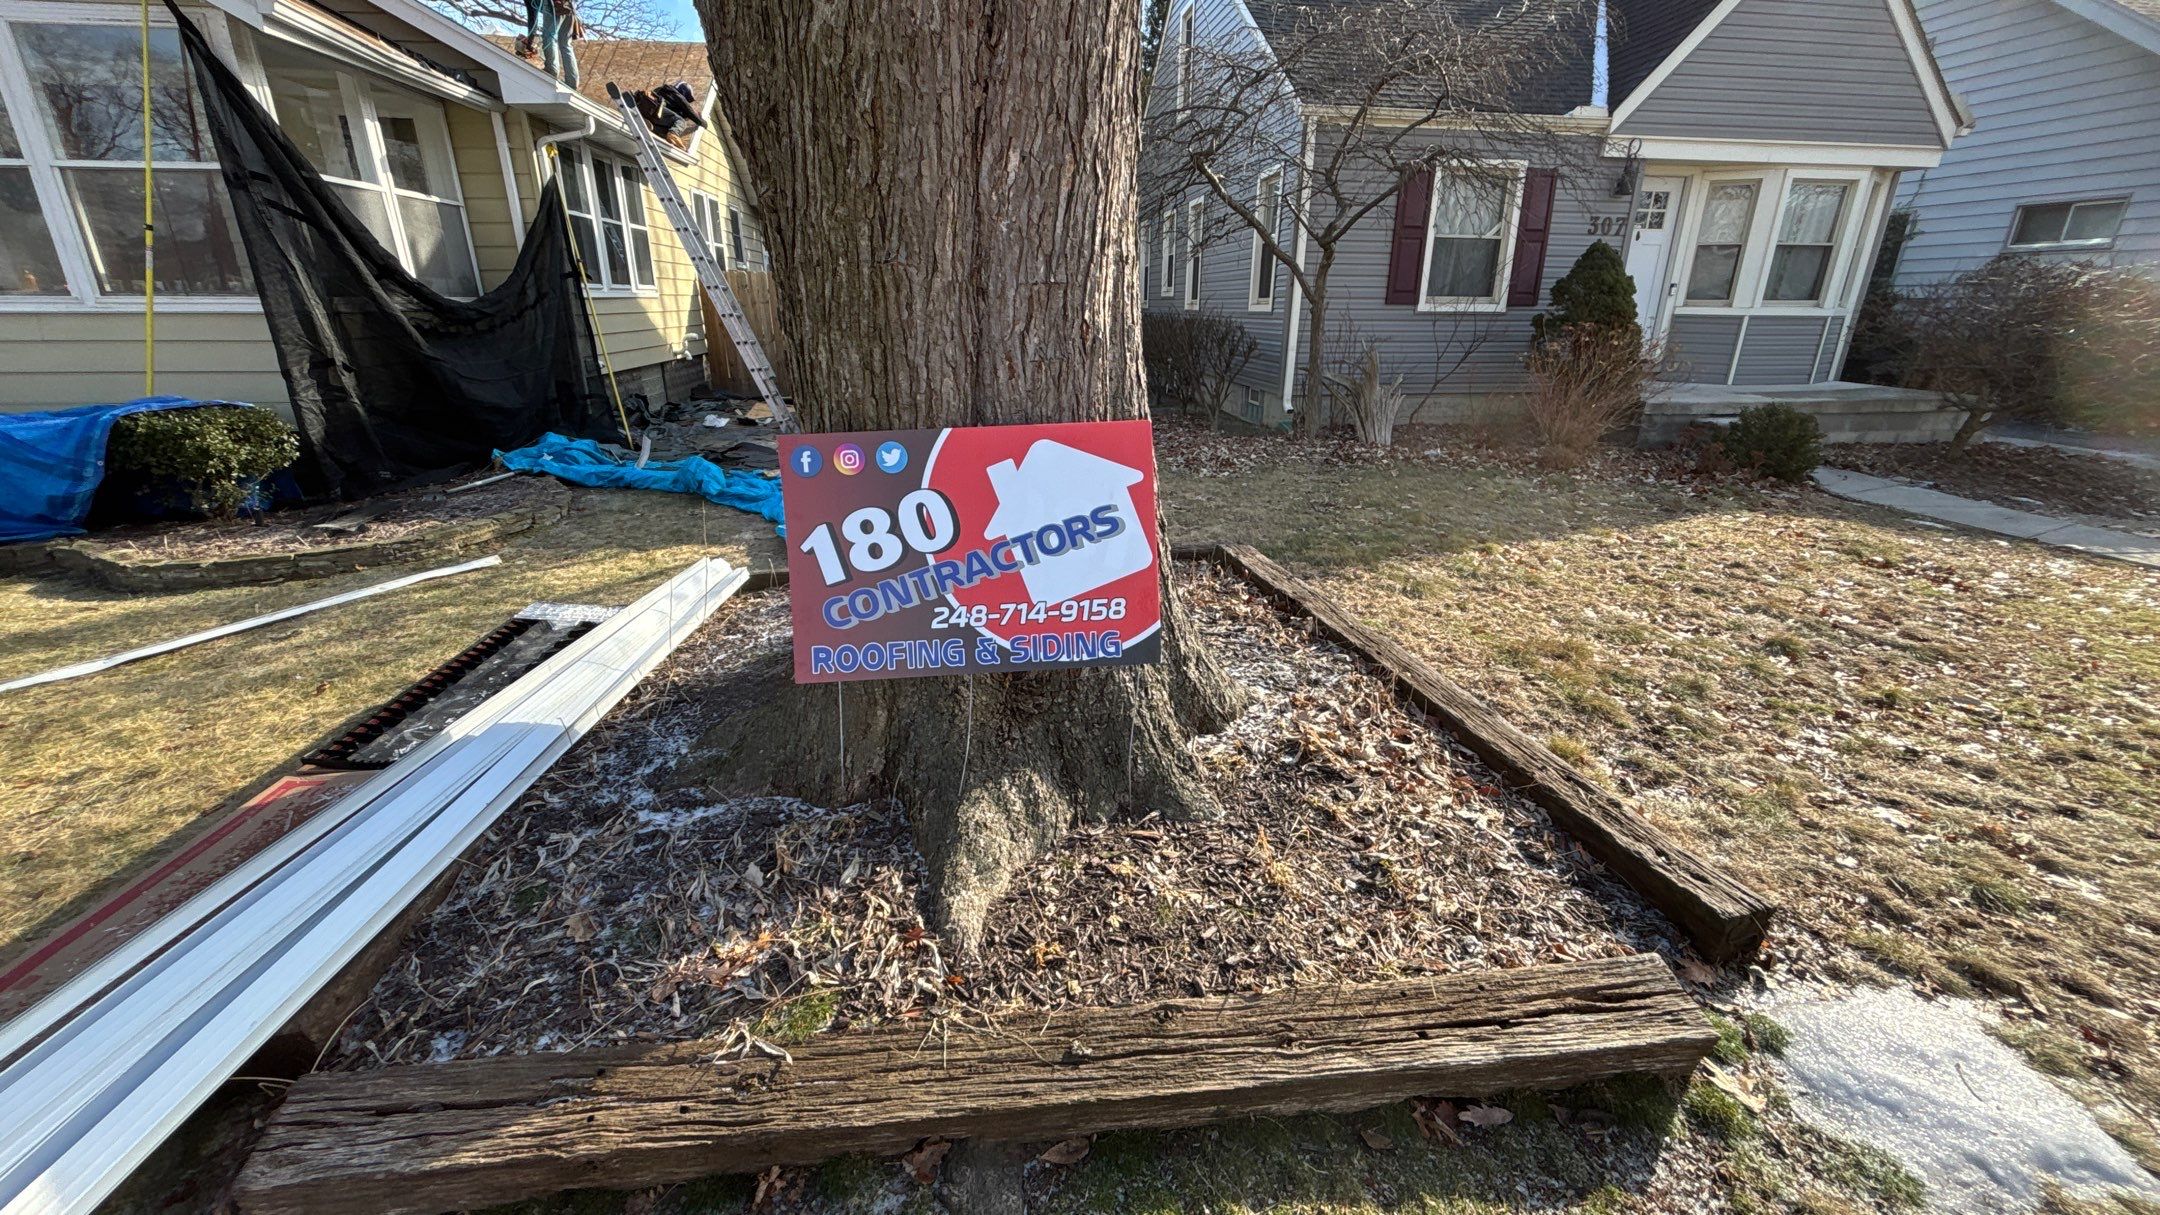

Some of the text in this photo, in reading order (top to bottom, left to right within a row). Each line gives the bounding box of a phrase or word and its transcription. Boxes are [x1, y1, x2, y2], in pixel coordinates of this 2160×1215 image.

[1588, 216, 1628, 236] 307
[800, 487, 960, 586] 180
[821, 503, 1127, 630] CONTRACTORS
[931, 597, 1127, 629] 248-714-9158
[811, 630, 1122, 675] ROOFING & SIDING
